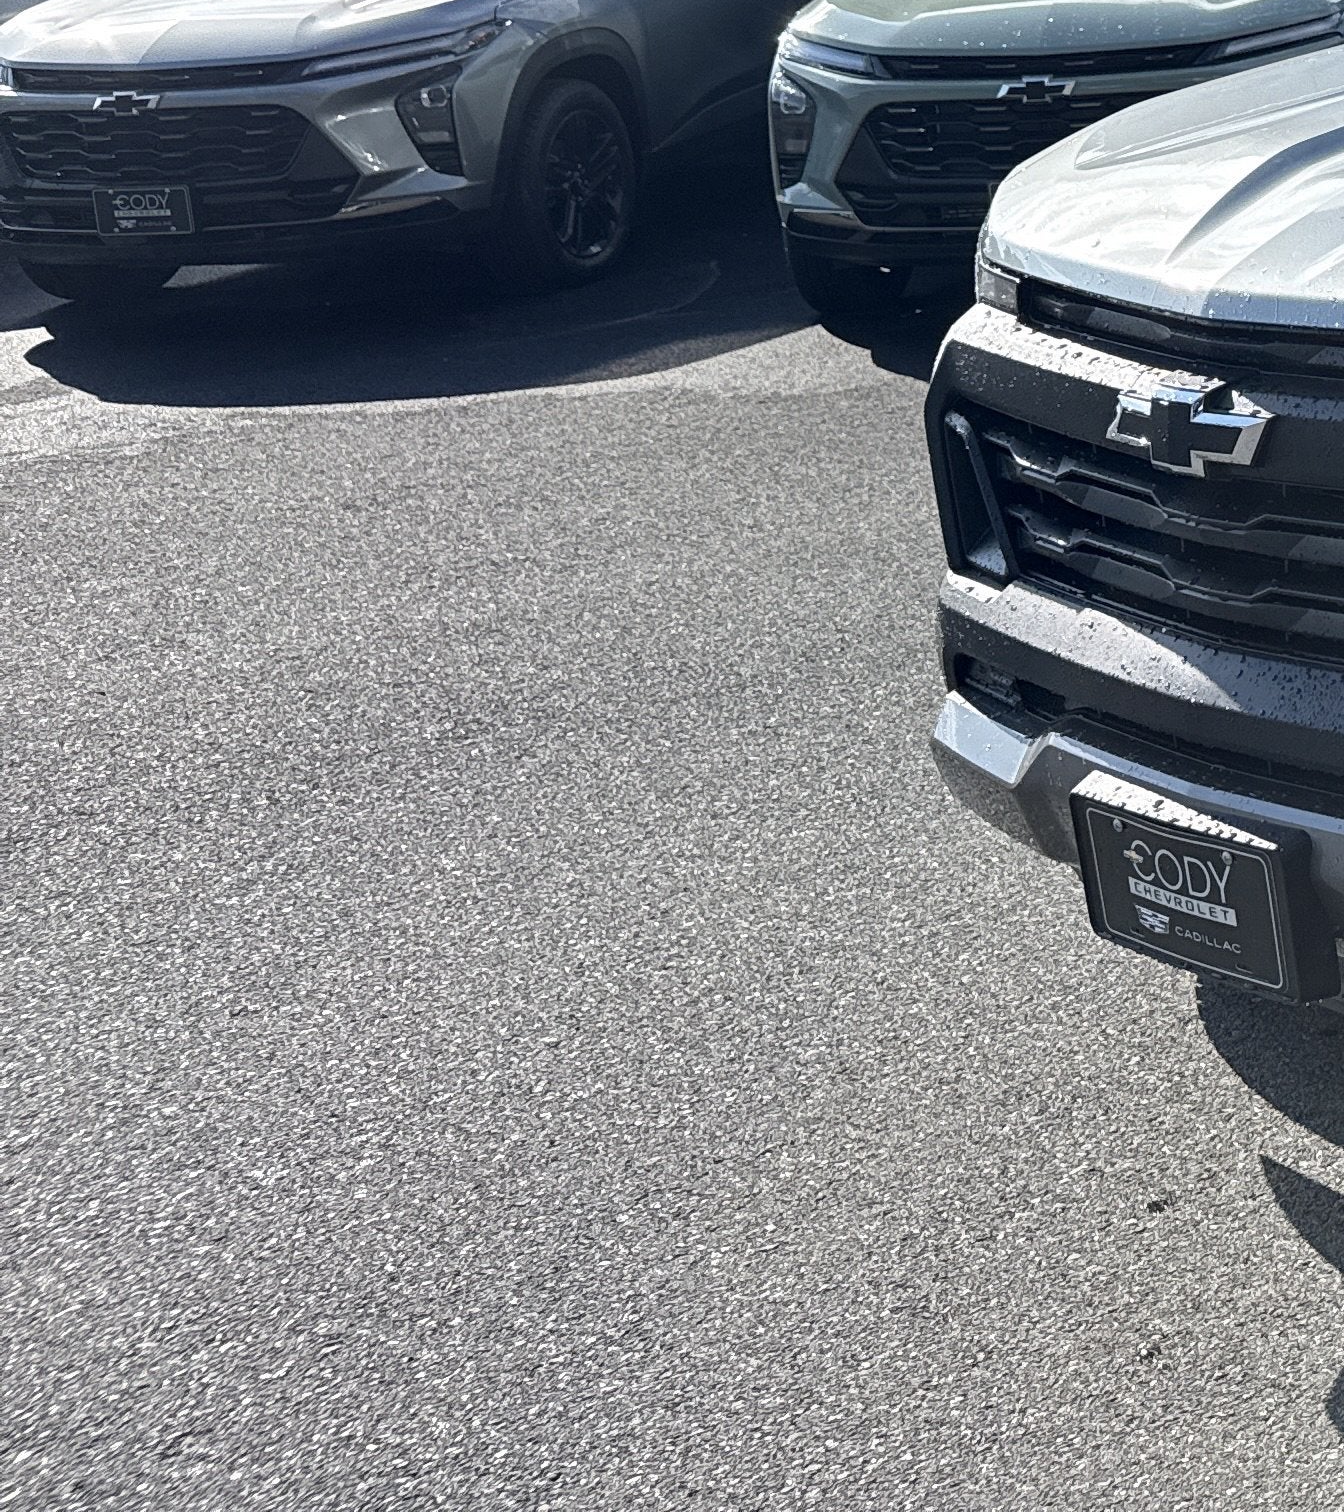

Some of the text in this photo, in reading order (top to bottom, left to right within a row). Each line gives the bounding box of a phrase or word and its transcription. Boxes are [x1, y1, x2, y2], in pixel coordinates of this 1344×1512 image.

[116, 191, 169, 210] CODY
[1127, 839, 1231, 904] CODY
[1133, 880, 1230, 922] CHEVROLET
[1174, 925, 1242, 954] CADILLAC
